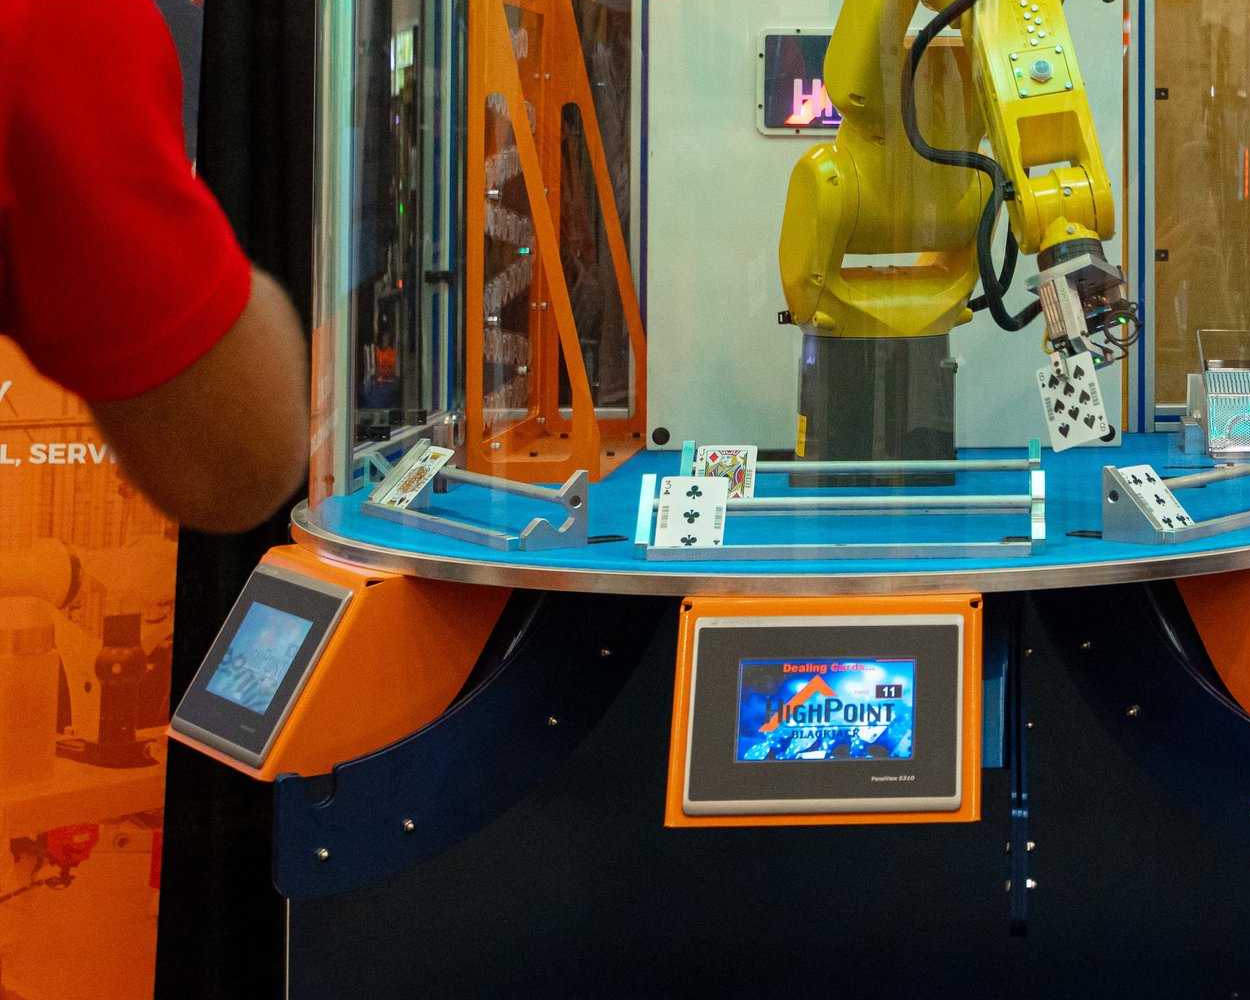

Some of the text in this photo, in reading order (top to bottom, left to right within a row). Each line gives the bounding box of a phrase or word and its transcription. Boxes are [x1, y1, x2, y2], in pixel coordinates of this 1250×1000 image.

[664, 480, 672, 490] 3
[783, 662, 828, 675] Dealing
[881, 686, 896, 698] 11
[791, 729, 861, 740] BLACKJACK
[898, 774, 916, 782] 5310
